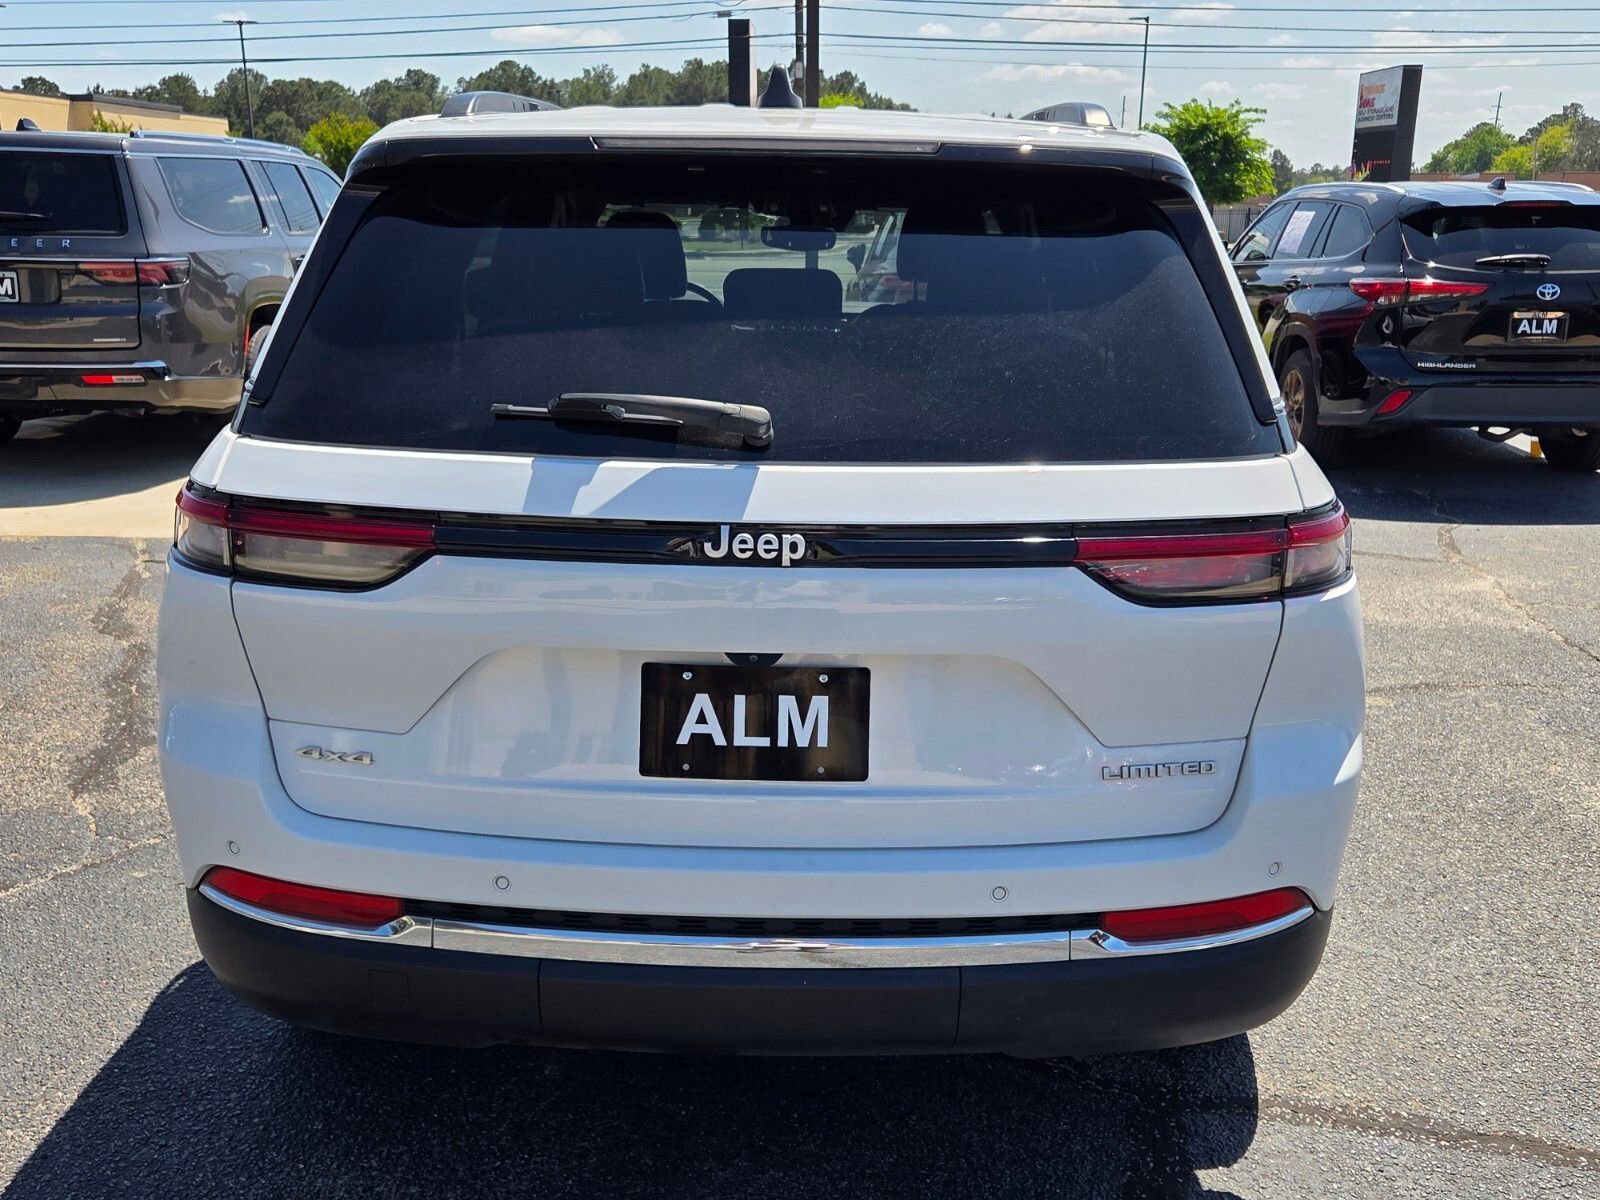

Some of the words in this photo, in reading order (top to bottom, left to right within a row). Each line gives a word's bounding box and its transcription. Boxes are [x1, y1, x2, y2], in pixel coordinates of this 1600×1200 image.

[1517, 319, 1558, 334] ALM
[1417, 361, 1476, 369] HIGHLANDER
[703, 524, 806, 567] Jeep
[676, 692, 829, 748] ALM
[295, 745, 375, 766] 4x4
[1101, 760, 1217, 781] LIMITED
